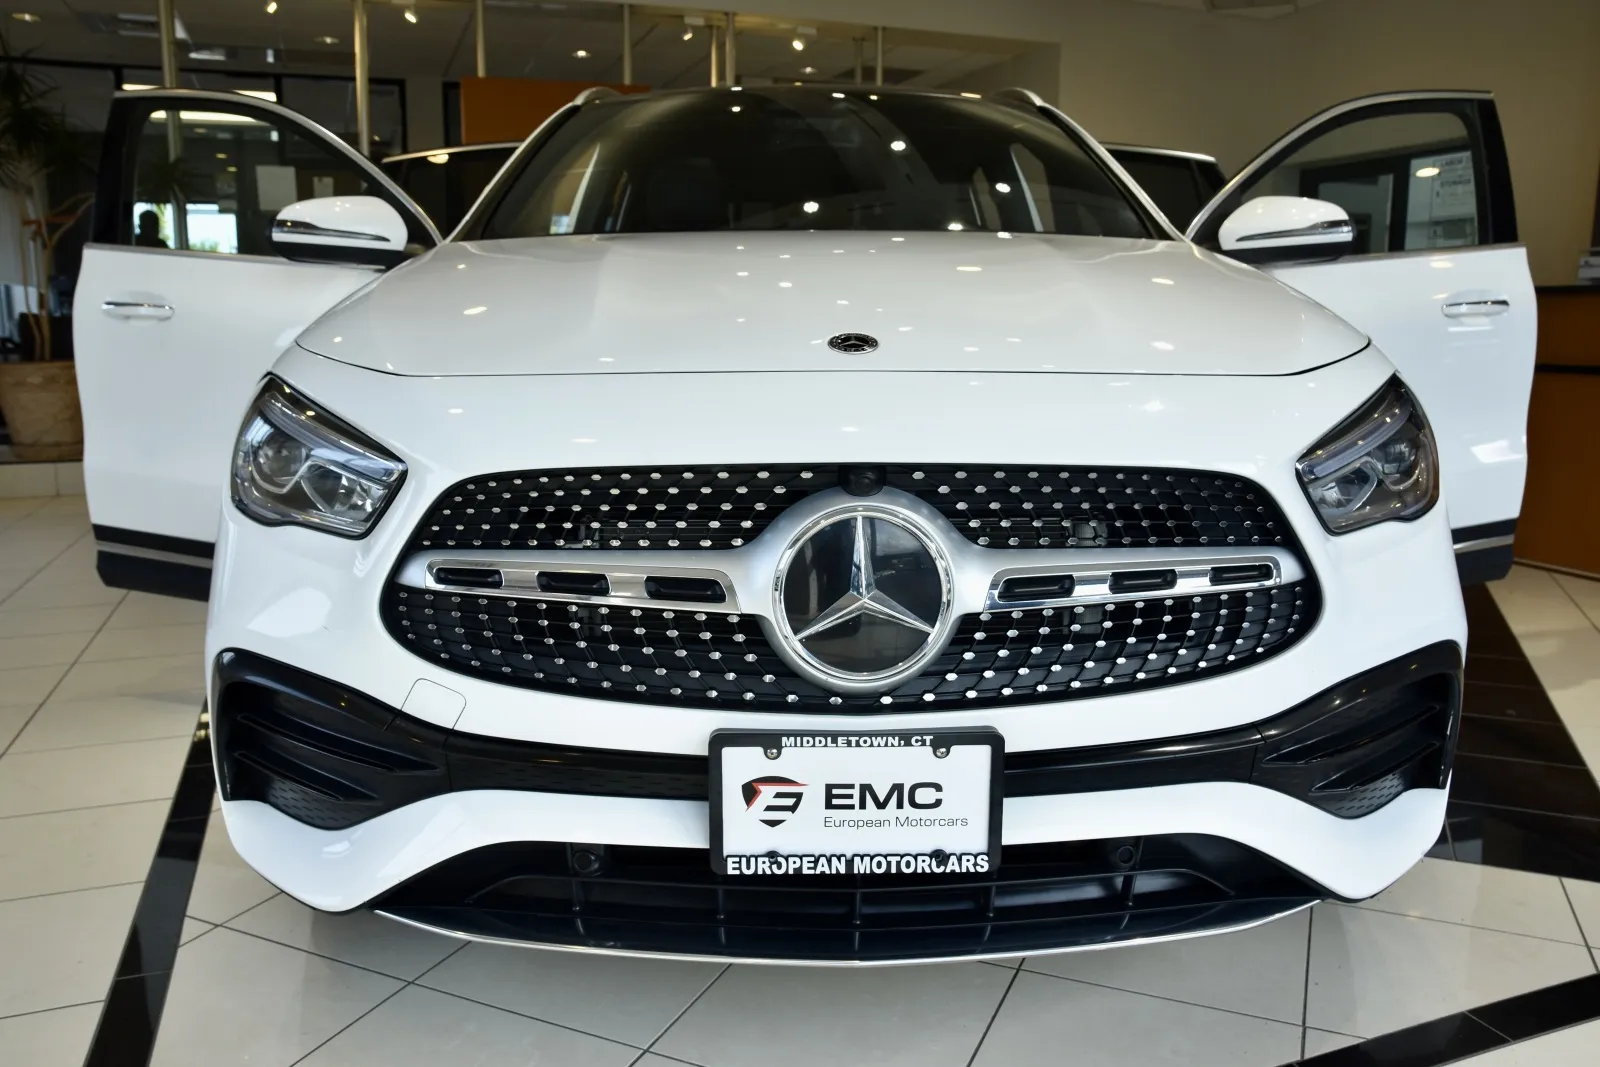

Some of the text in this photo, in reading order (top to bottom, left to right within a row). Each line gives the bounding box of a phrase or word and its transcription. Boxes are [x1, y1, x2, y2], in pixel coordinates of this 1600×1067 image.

[781, 736, 933, 748] MIDDLETOWN, CT
[825, 782, 943, 810] EMC
[824, 815, 968, 830] European Motorcars
[726, 855, 989, 875] EUROPEAN MOTORCARS
